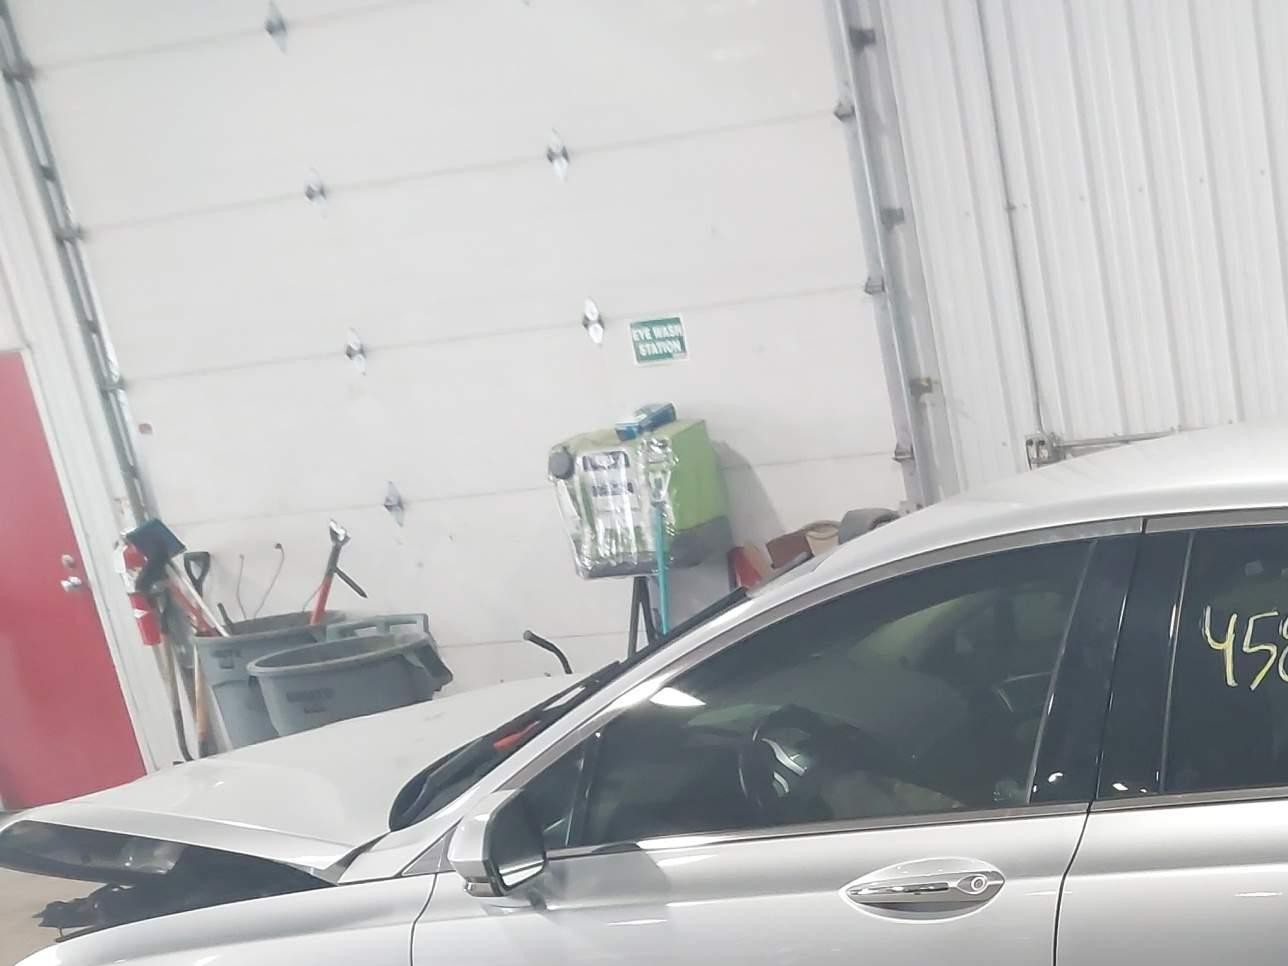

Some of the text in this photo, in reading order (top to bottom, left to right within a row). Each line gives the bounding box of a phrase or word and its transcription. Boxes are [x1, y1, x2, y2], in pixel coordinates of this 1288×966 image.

[632, 323, 682, 341] EYE WASH
[639, 339, 682, 356] STATION
